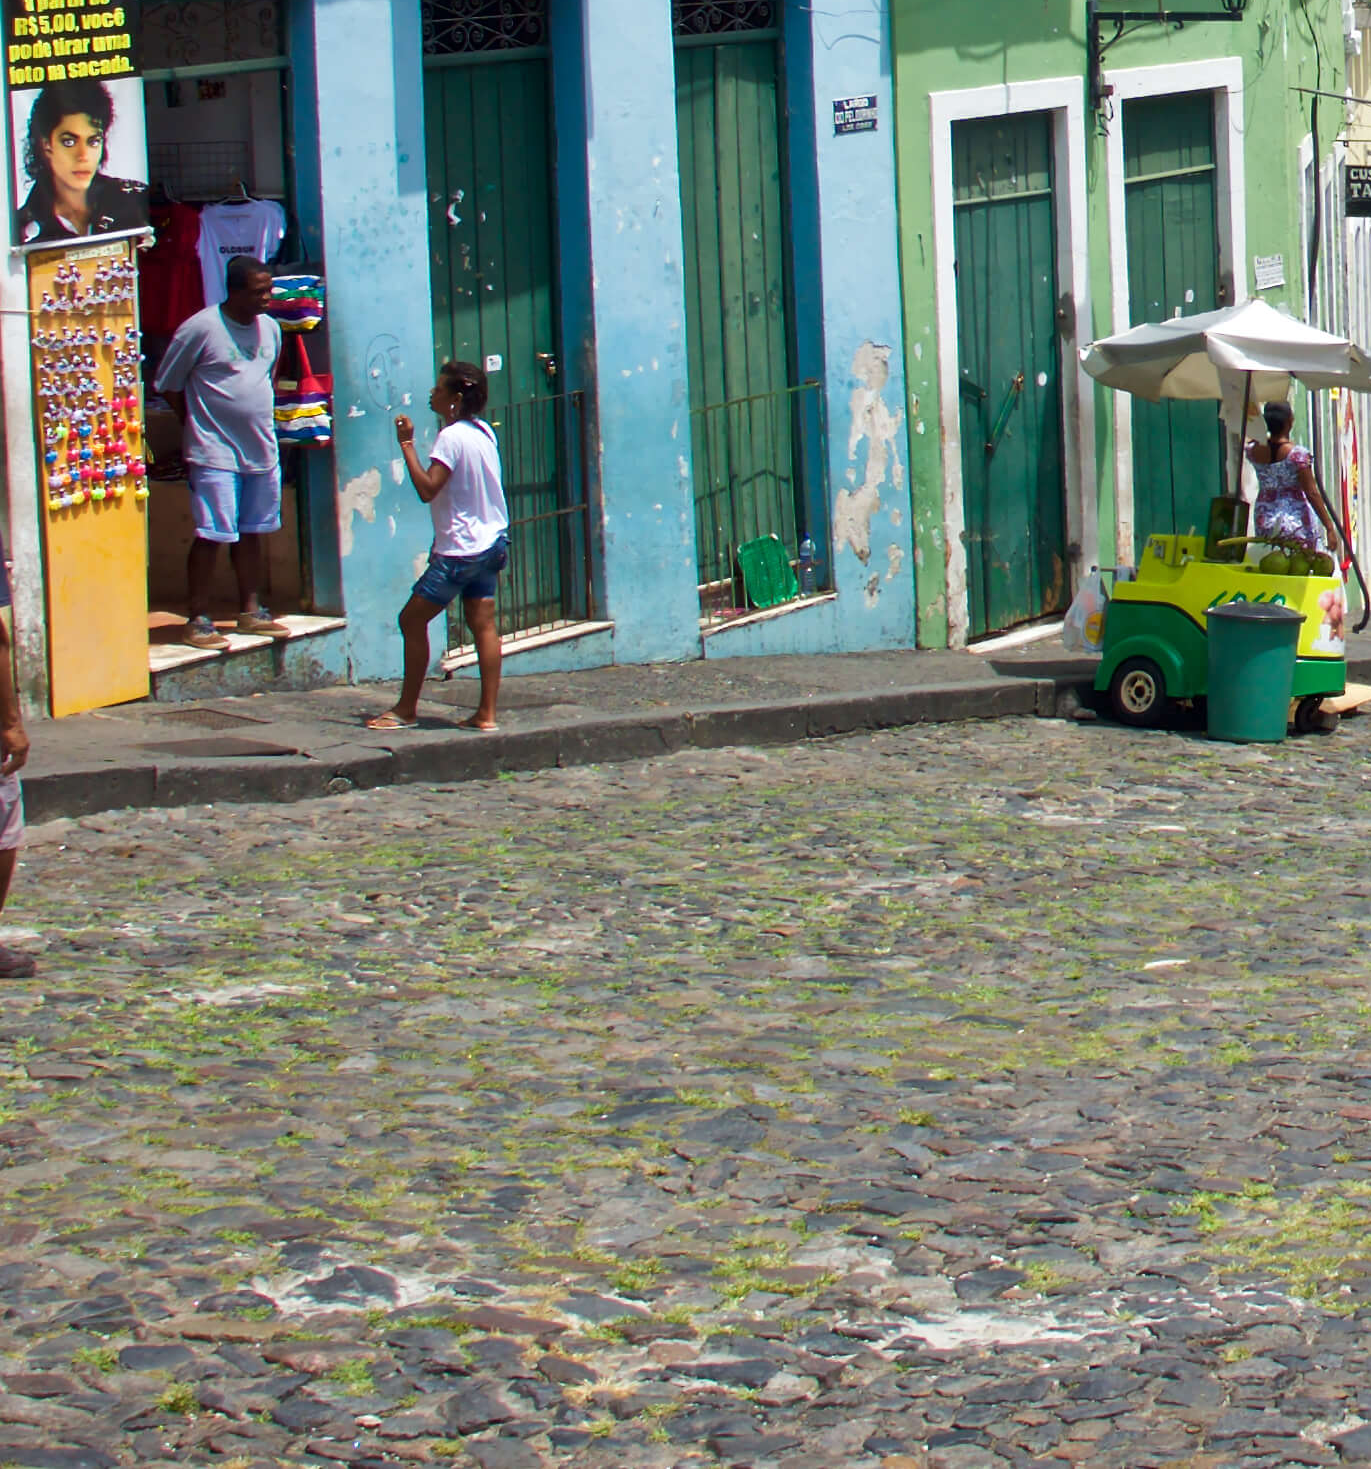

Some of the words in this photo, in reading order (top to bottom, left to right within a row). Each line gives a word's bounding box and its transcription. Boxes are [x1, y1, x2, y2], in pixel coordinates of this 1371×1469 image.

[81, 7, 125, 30] você
[8, 39, 52, 63] pode
[52, 37, 91, 56] tirar
[92, 33, 131, 52] uma
[8, 65, 45, 85] foto
[47, 64, 67, 81] na
[67, 55, 135, 79] sacada.
